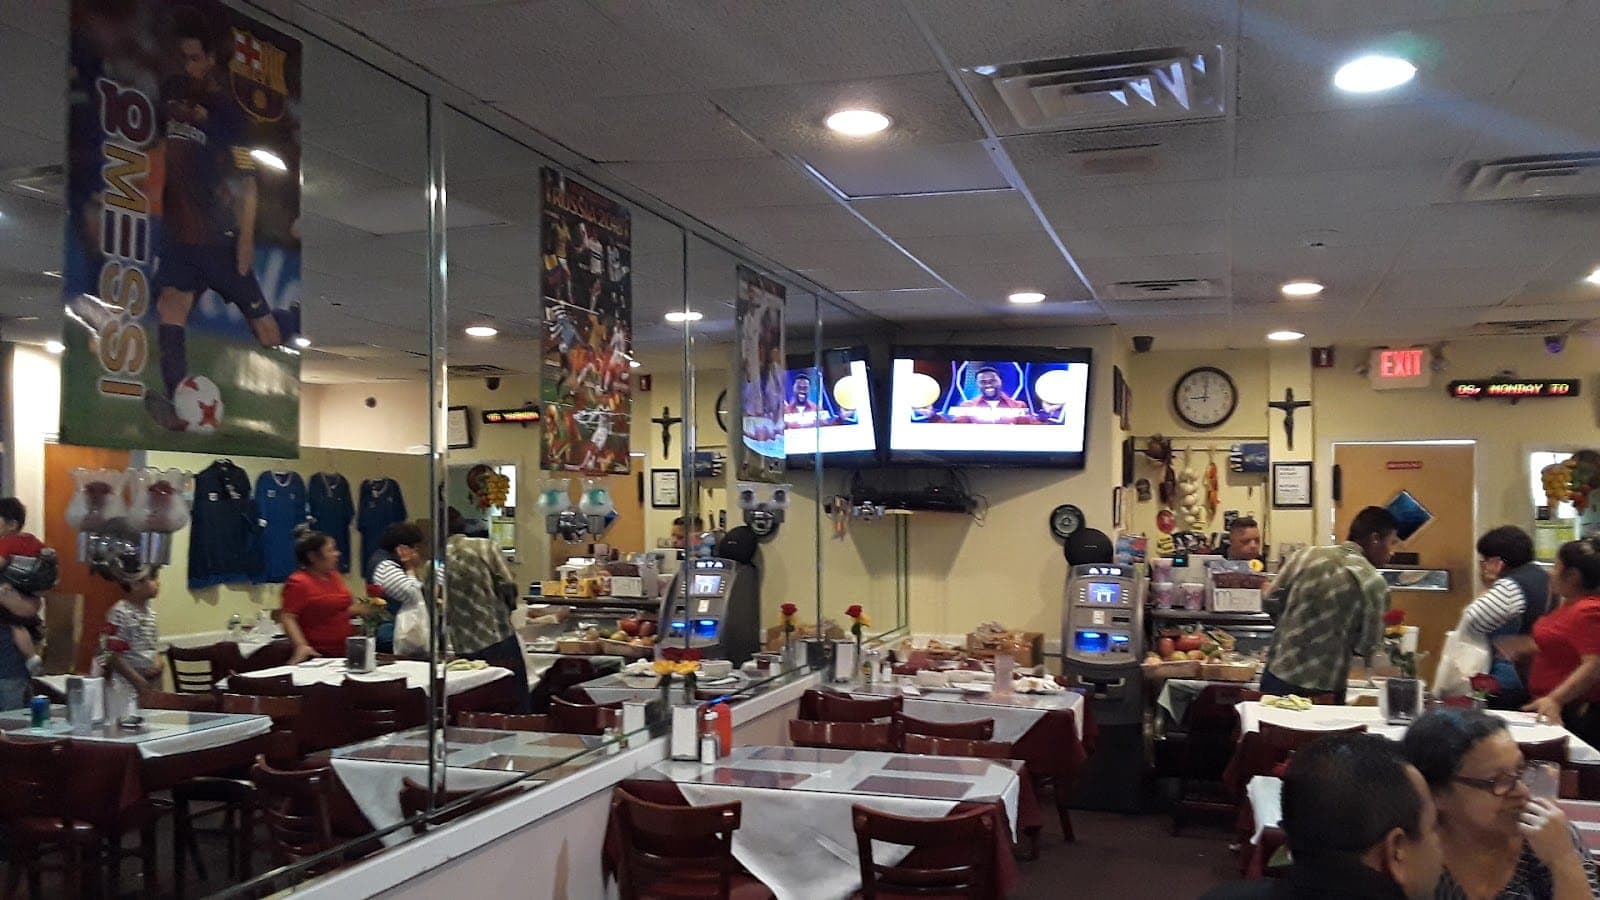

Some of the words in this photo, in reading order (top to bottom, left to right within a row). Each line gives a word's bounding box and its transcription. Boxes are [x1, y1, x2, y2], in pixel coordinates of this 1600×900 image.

[99, 142, 149, 398] MESSI
[1381, 350, 1423, 377] EXIT
[1488, 383, 1543, 395] MONDAY
